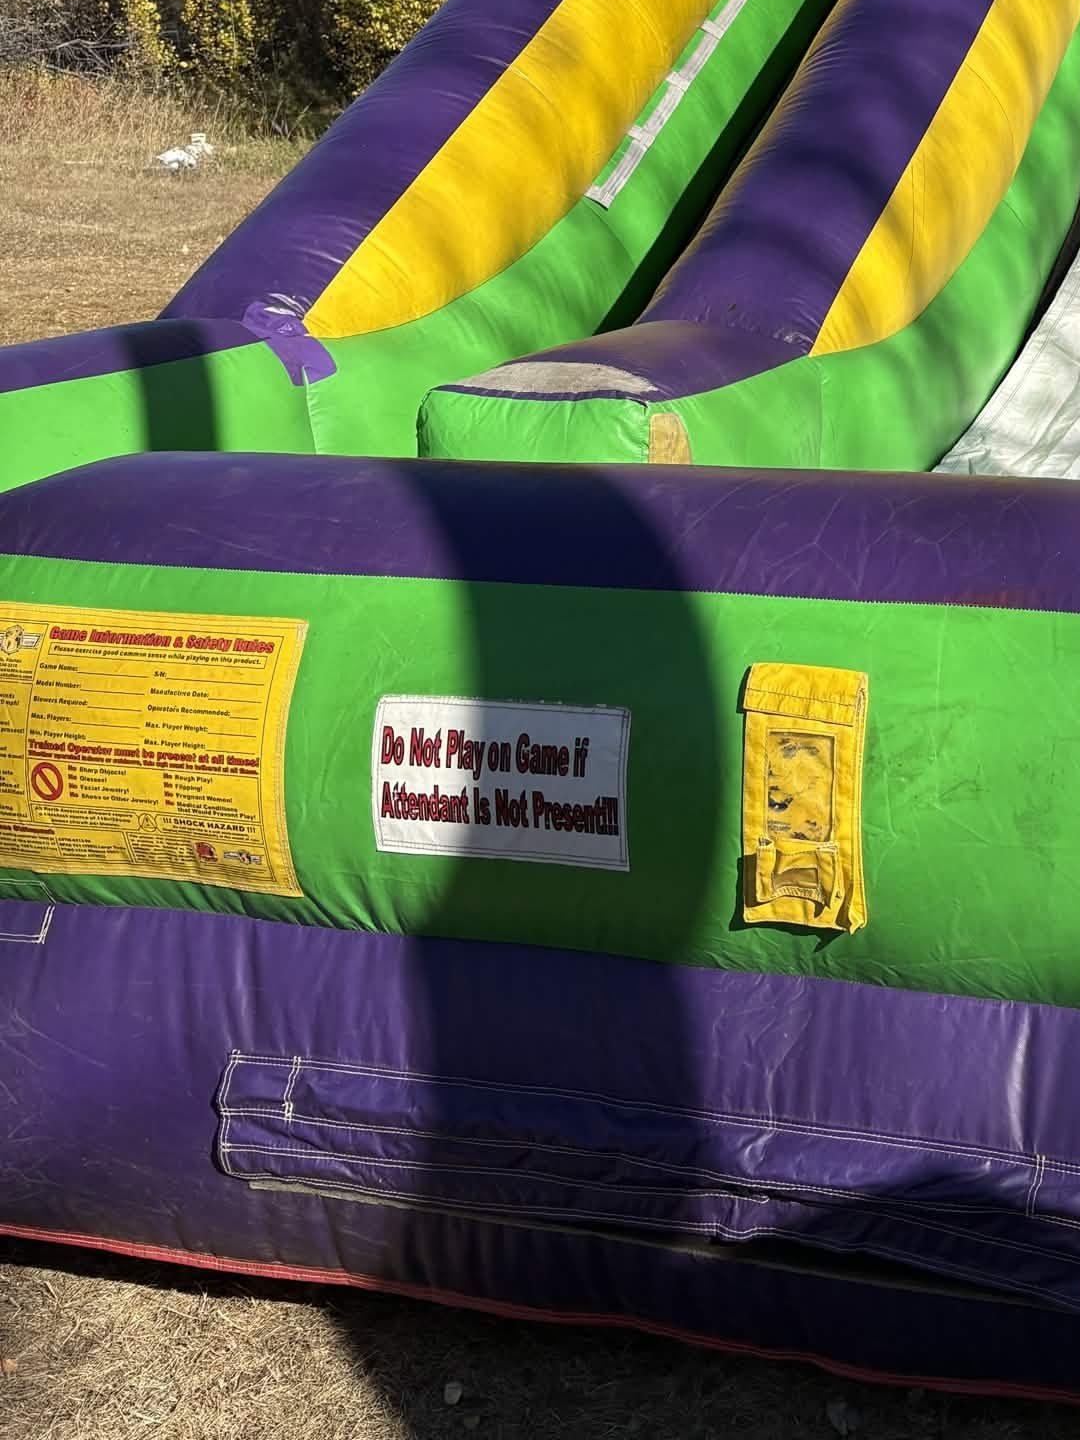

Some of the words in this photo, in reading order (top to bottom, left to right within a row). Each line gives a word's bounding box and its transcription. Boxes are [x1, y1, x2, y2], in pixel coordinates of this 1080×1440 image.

[50, 626, 87, 641] Game
[88, 629, 171, 647] Information
[173, 636, 183, 648] &
[186, 635, 232, 652] Safety
[233, 638, 275, 654] Rules
[102, 648, 118, 656] good
[186, 654, 209, 663] playing
[40, 662, 57, 670] Game
[33, 696, 58, 704] Blowers
[59, 697, 88, 706] Required:
[181, 707, 230, 716] Recommended:
[47, 714, 71, 722] Players:
[162, 723, 182, 731] Player
[44, 730, 63, 738] Player
[64, 732, 86, 740] Height:
[144, 738, 159, 746] Max.
[161, 740, 181, 748] Player
[28, 739, 65, 751] Trained
[67, 742, 112, 754] Operator
[114, 747, 140, 758] must
[142, 748, 154, 758] be
[157, 751, 196, 762] present
[198, 754, 209, 764] at
[211, 754, 224, 764] all
[226, 755, 259, 767] times!
[381, 726, 404, 765] Do
[410, 728, 442, 768] Not
[446, 730, 486, 780] Play
[488, 740, 511, 772] on
[516, 733, 570, 776] Game
[573, 737, 590, 777] if
[174, 774, 195, 782] Rough
[196, 776, 212, 784] Play!
[381, 782, 470, 824] Attendant
[474, 787, 492, 825] Is
[495, 788, 530, 828] Not
[173, 818, 205, 828] SHOCK
[206, 822, 245, 832] HAZARD
